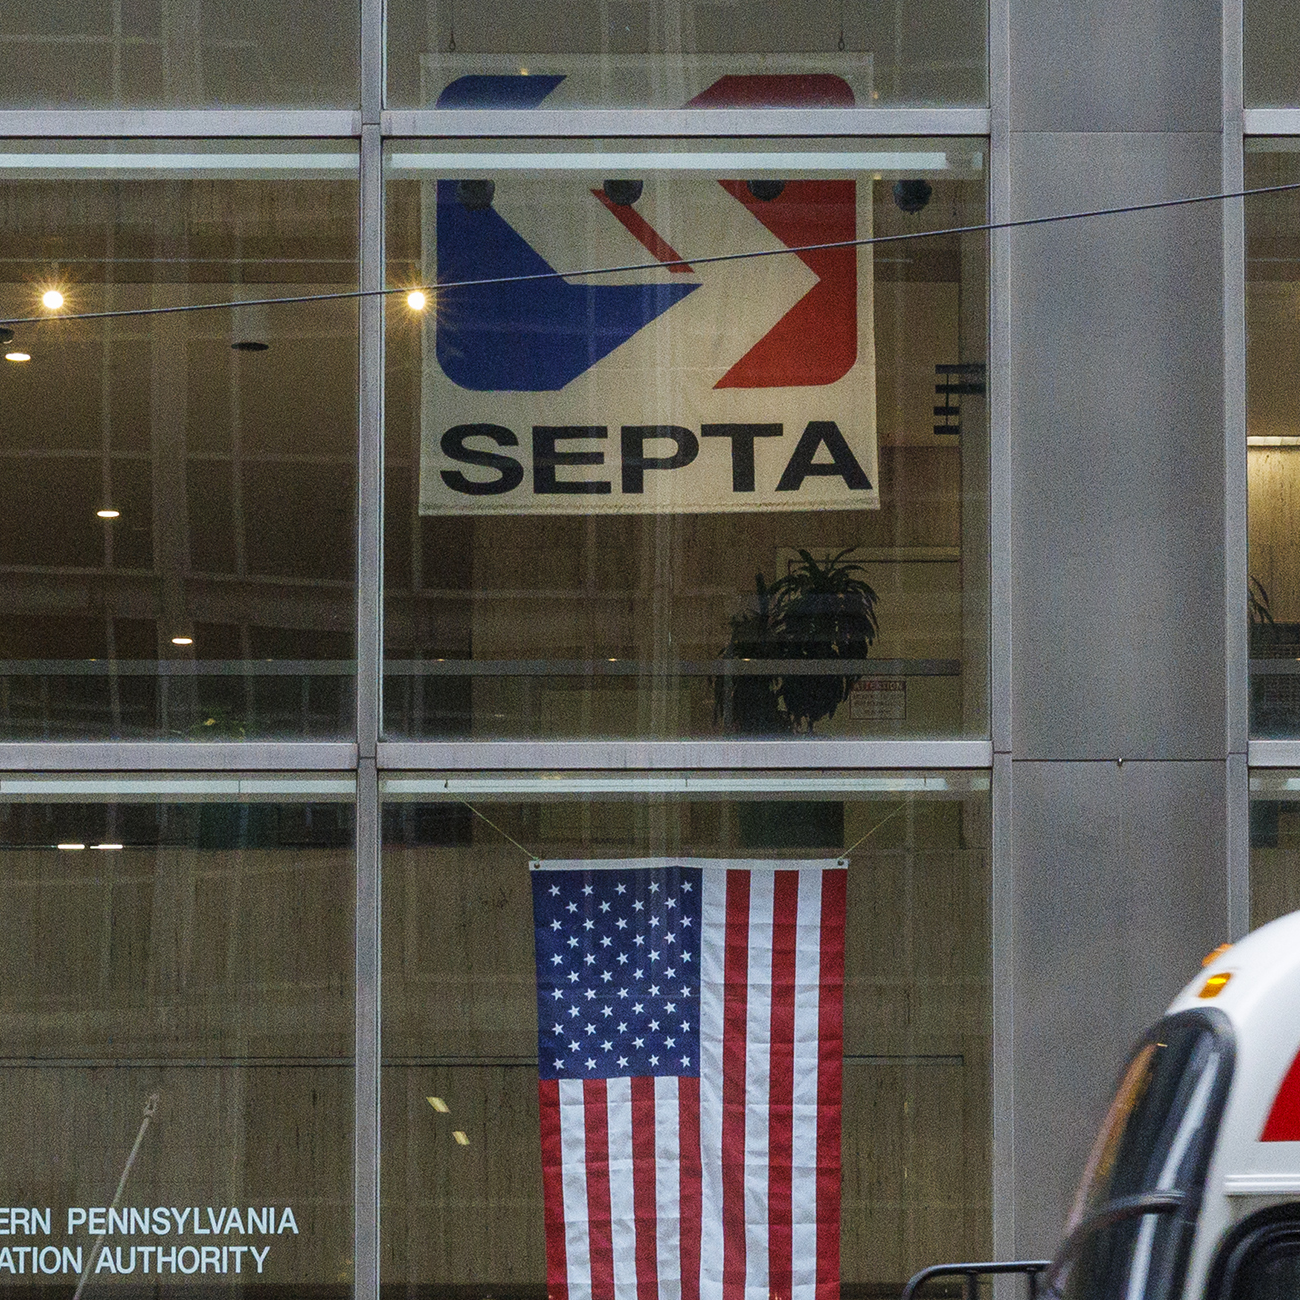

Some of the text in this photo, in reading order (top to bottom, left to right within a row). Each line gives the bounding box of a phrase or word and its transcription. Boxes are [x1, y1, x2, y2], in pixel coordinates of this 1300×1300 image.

[440, 421, 873, 495] SEPTA
[68, 1207, 299, 1236] PENNSYLVANIA
[95, 1245, 271, 1274] AUTHORITY
